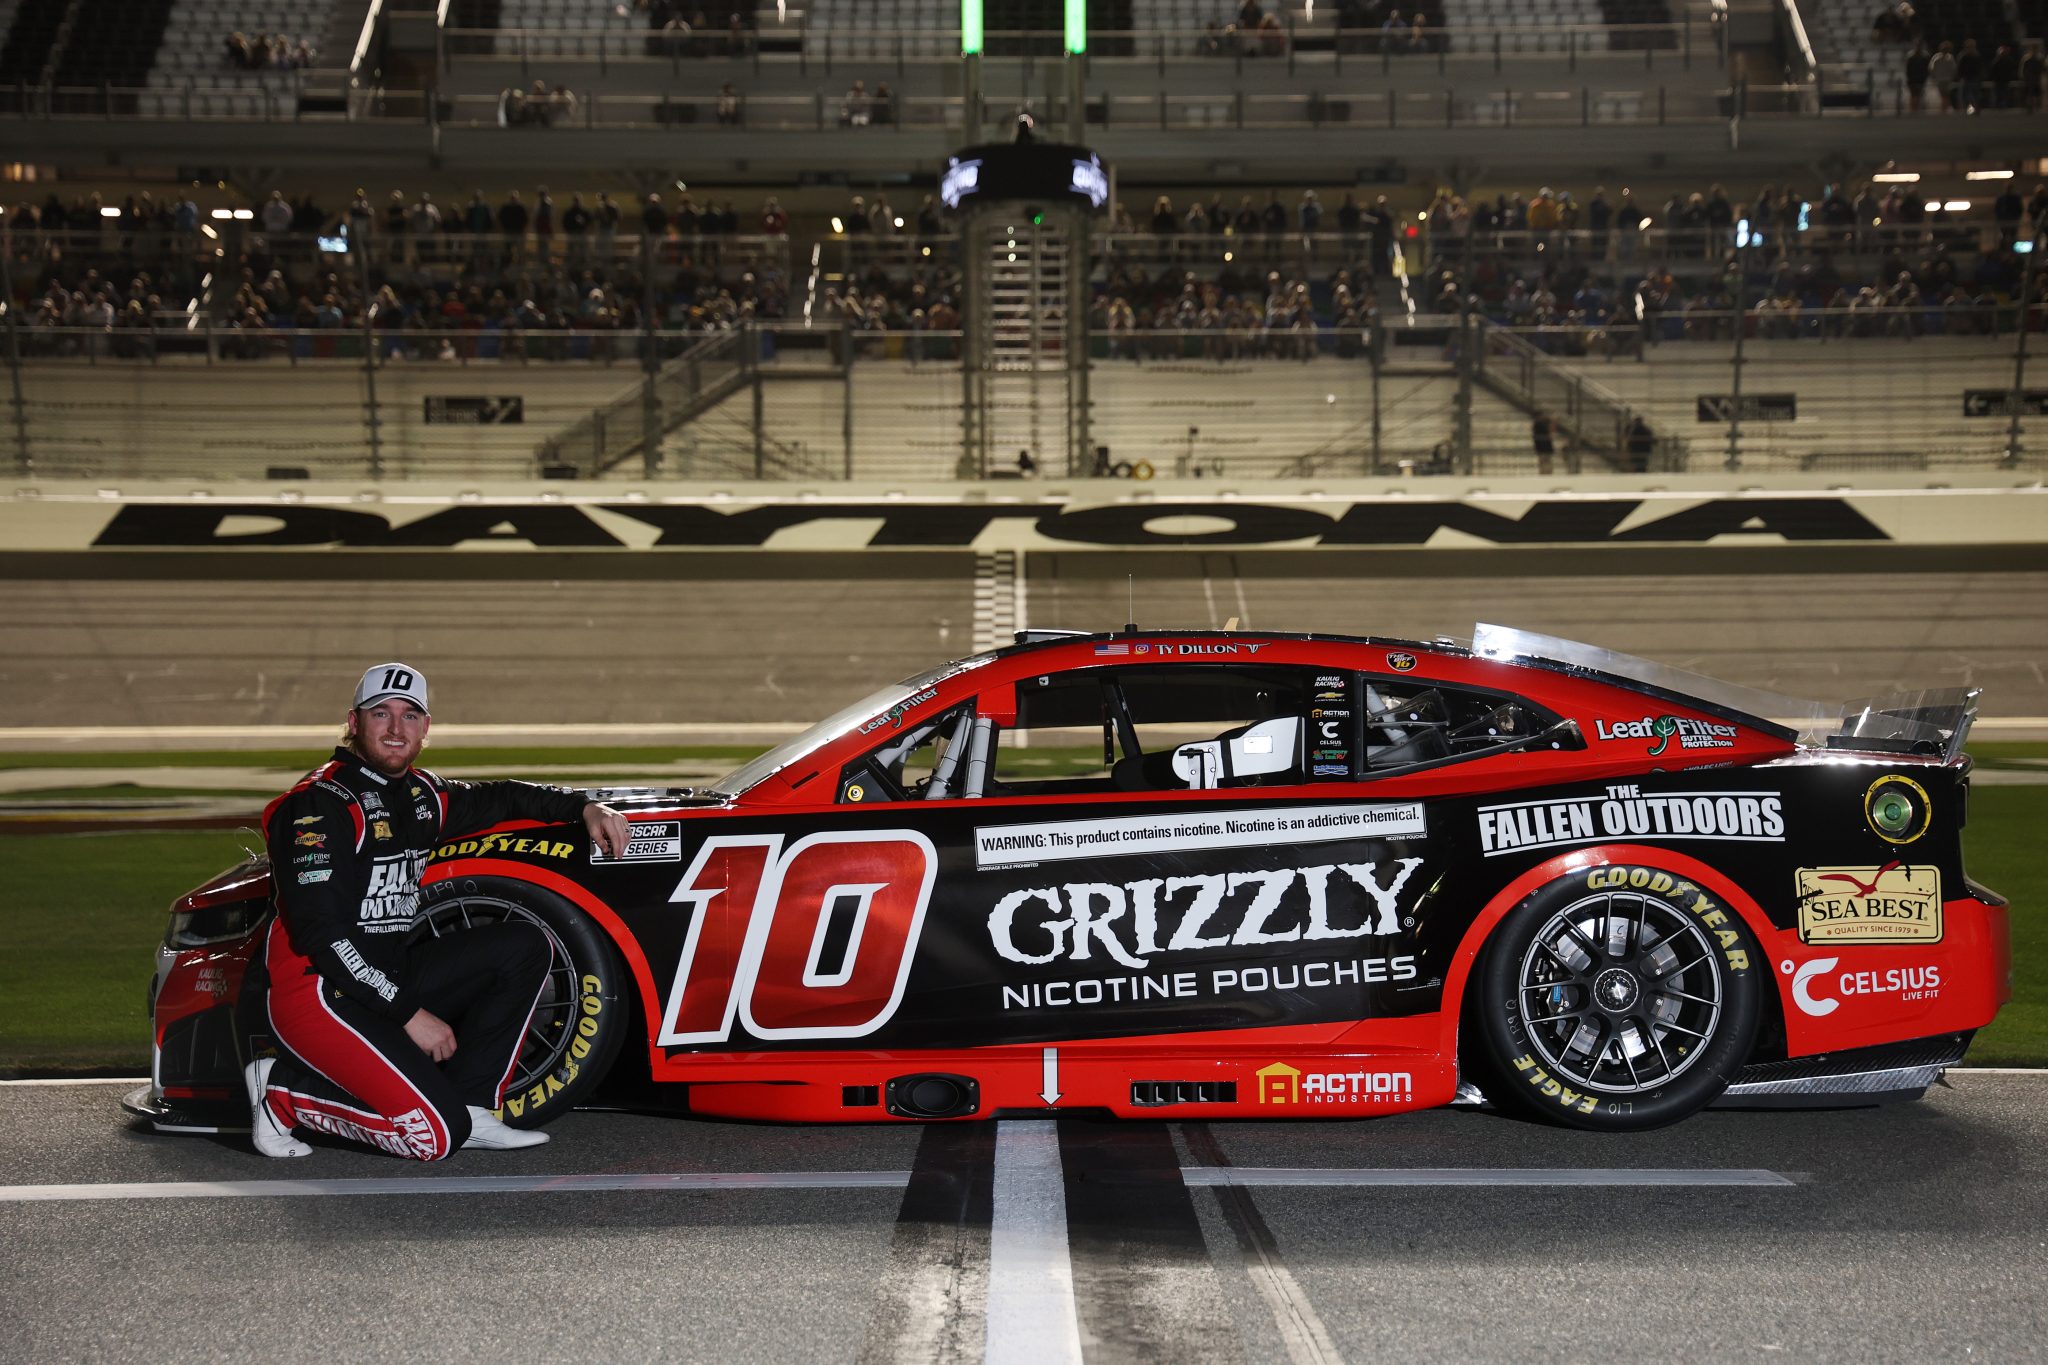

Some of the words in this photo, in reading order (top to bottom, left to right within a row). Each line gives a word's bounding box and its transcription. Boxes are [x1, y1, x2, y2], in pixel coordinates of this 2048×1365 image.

[89, 498, 1894, 549] DAYTONA
[1154, 644, 1174, 655] TY
[1178, 643, 1238, 655] DILLON
[382, 669, 413, 691] 10
[857, 711, 890, 735] Leaf
[900, 687, 939, 712] Filter
[1595, 717, 1654, 740] Leaf
[1674, 717, 1738, 737] Filter
[1682, 740, 1734, 749] PROTECTION
[1606, 784, 1642, 799] THE
[981, 833, 1048, 852] WARNING:
[1048, 831, 1074, 847] This
[1077, 829, 1121, 848] product
[1123, 826, 1172, 843] contains
[1174, 821, 1224, 838] nicotine.
[1225, 818, 1275, 834] Nicotine
[1278, 817, 1289, 831] is
[1290, 819, 1305, 830] an
[1307, 811, 1361, 829] addictive
[1362, 806, 1420, 824] chemical.
[1478, 803, 1594, 851] FALLEN
[1601, 797, 1785, 836] OUTDOORS
[295, 833, 326, 846] SUNOCO
[627, 842, 669, 855] SERIES
[293, 854, 308, 864] Leaf
[986, 857, 1424, 968] GRIZZLY
[1586, 866, 1750, 972] GOODYEAR
[1811, 899, 1860, 922] SEA
[1865, 898, 1929, 920] BEST
[656, 828, 939, 1047] 10
[1834, 926, 1868, 935] QUALITY
[1894, 926, 1912, 934] 1979
[1002, 973, 1198, 1009] NICOTINE
[1213, 955, 1417, 995] POUCHES
[1839, 966, 1940, 996] CELSIUS
[1902, 991, 1922, 1001] LIVE
[1924, 989, 1940, 999] FIT
[1302, 1072, 1412, 1093] ACTION
[1512, 1053, 1599, 1115] EAGLE
[1306, 1094, 1413, 1104] INDUSTRIES
